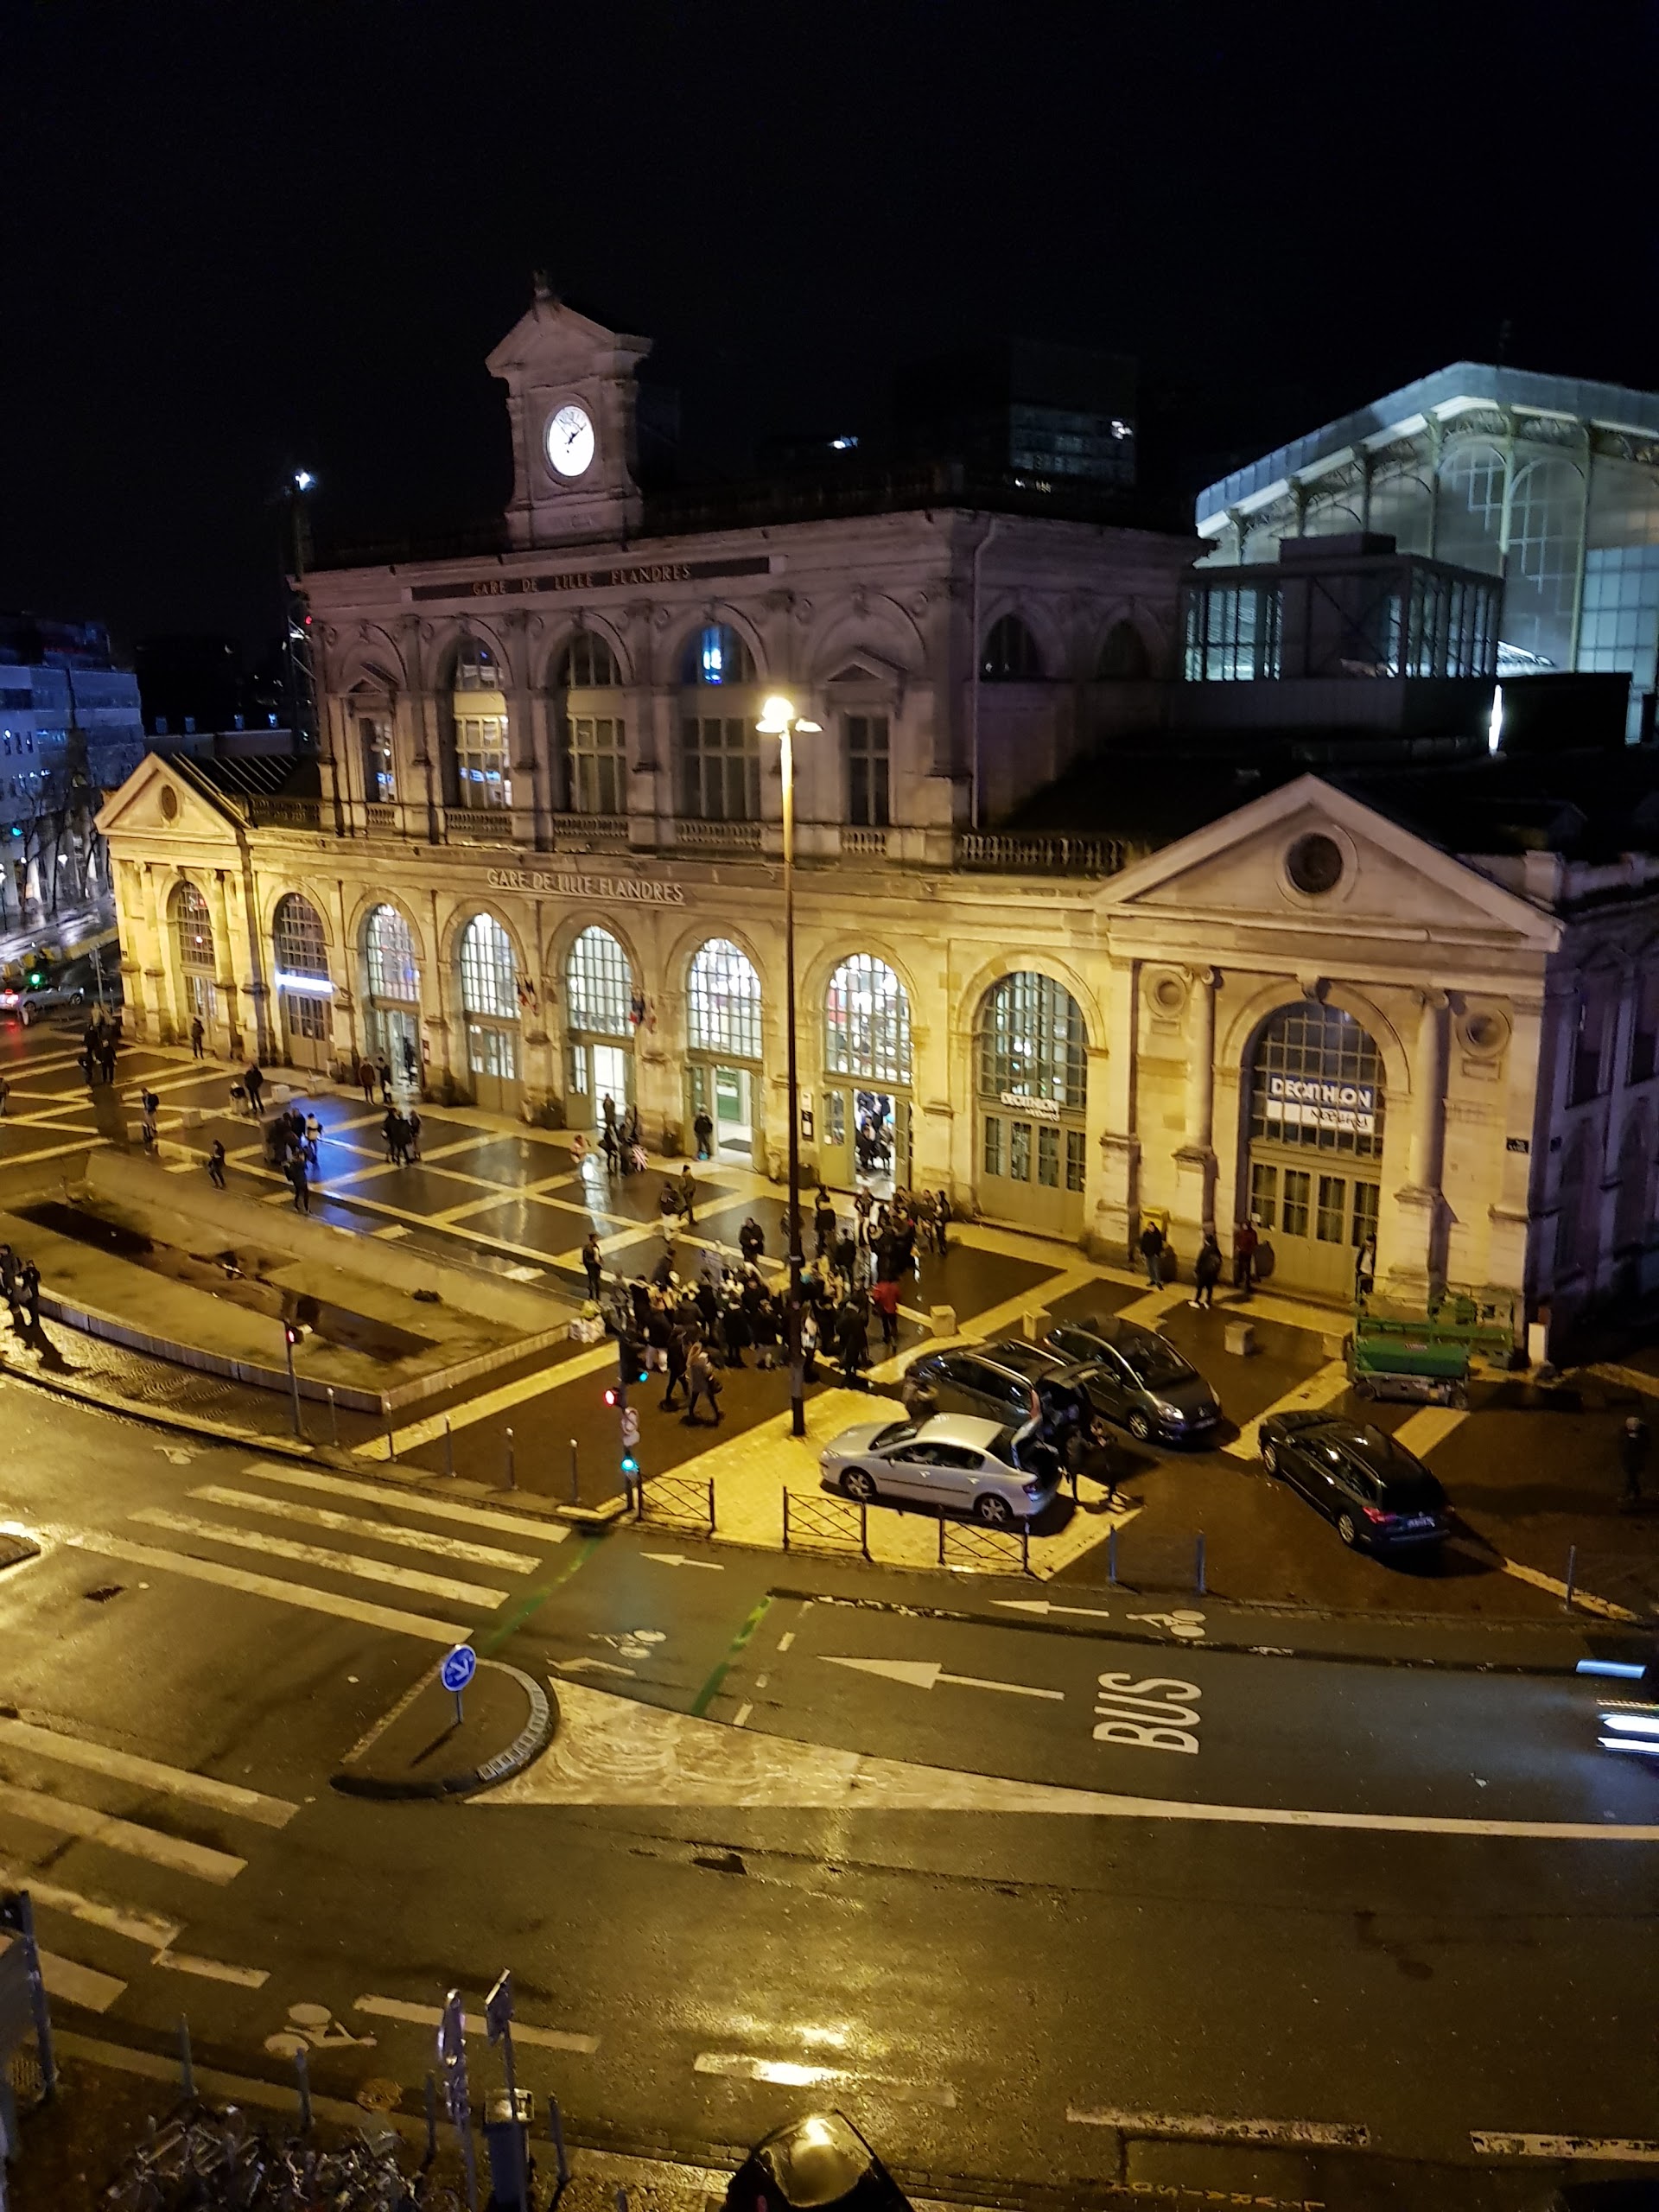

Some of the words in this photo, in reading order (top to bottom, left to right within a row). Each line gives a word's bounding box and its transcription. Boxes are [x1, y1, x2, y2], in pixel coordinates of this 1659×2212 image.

[473, 581, 506, 596] GARE
[521, 578, 538, 593] DE
[554, 572, 594, 591] LILLE
[610, 564, 691, 586] FLANDRES
[486, 868, 527, 888] GARE
[532, 873, 552, 891] DE
[557, 874, 593, 895] LILLE
[599, 878, 684, 902] FLANDRES
[1092, 1671, 1203, 1756] BUS
